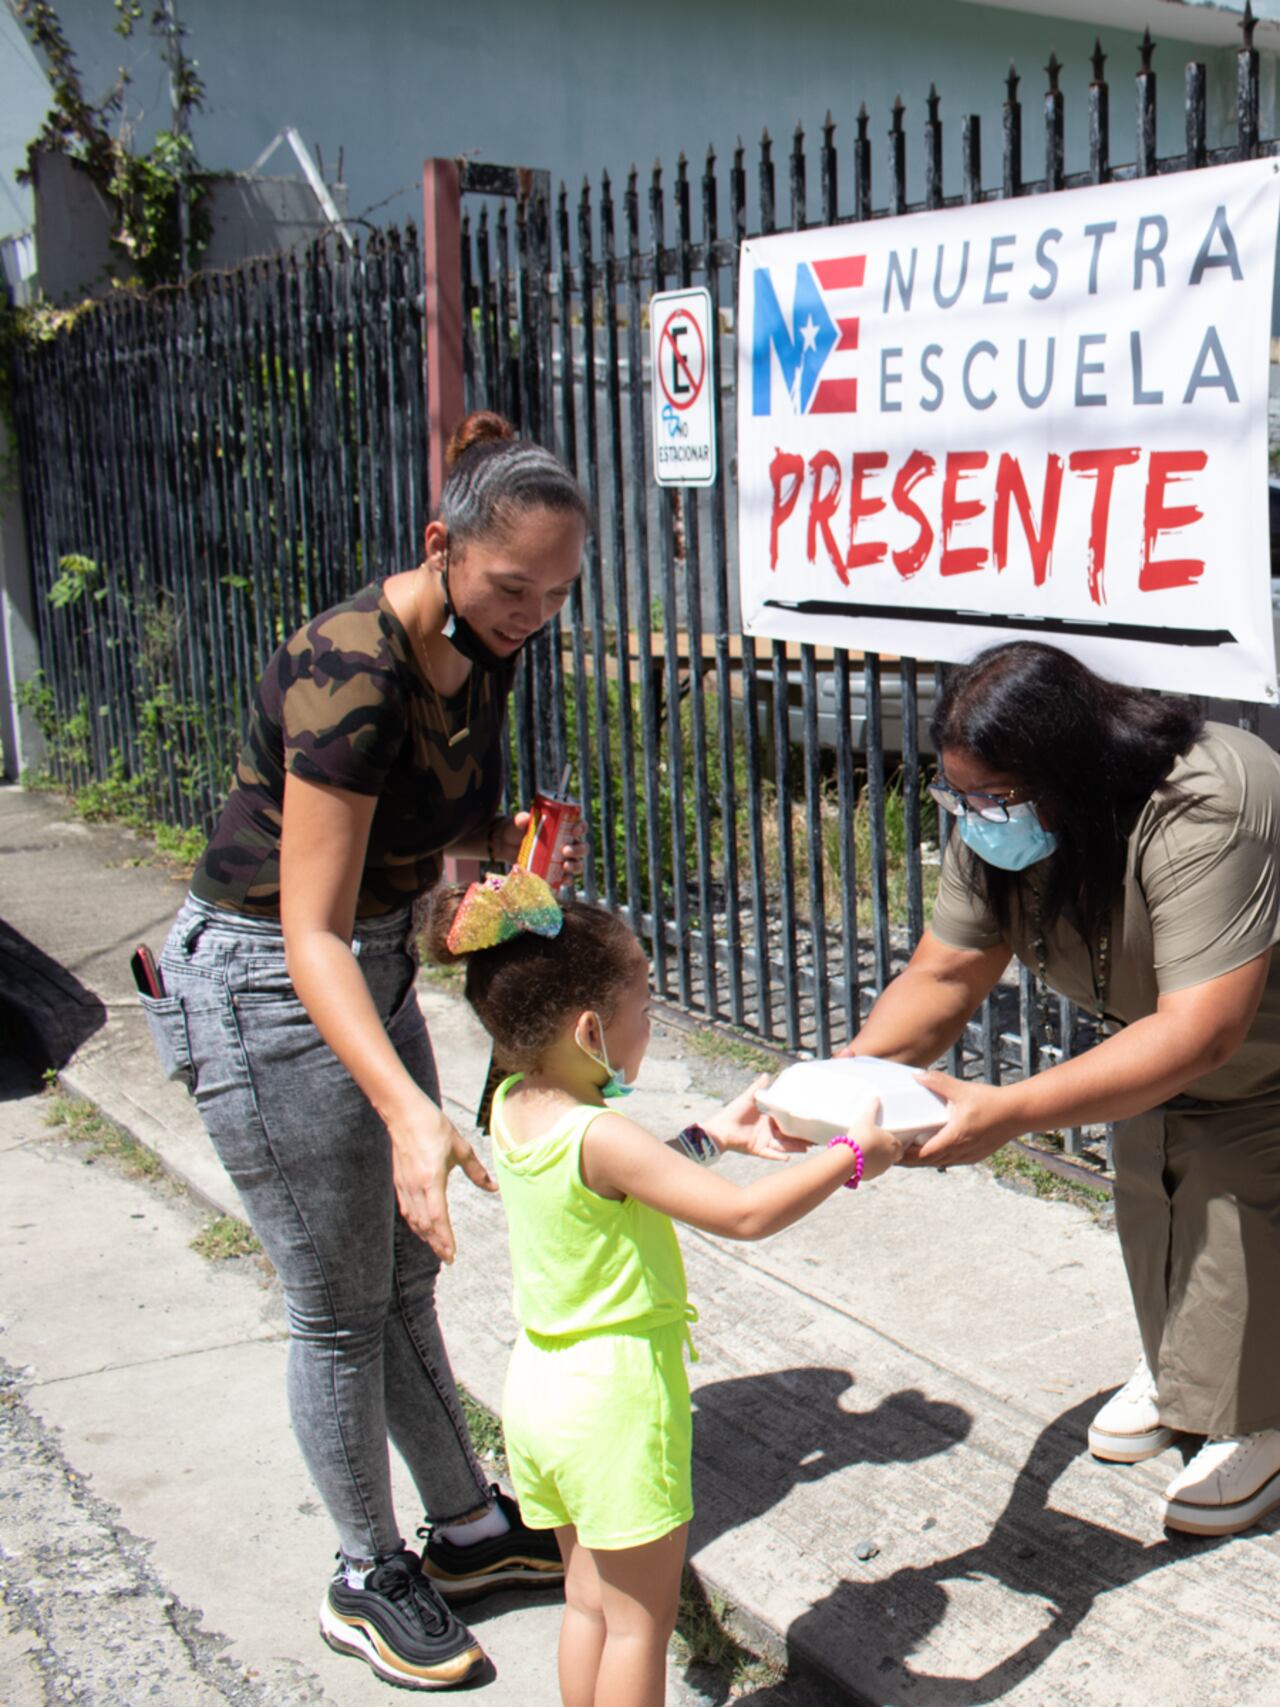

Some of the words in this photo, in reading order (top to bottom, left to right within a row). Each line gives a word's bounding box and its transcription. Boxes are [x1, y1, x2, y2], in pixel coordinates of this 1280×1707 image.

[883, 205, 1244, 313] NUESTRA
[672, 327, 690, 394] E
[880, 325, 1240, 413] ESCUELA
[659, 445, 709, 462] ESTACIONAR
[768, 446, 1208, 606] PRESENTE
